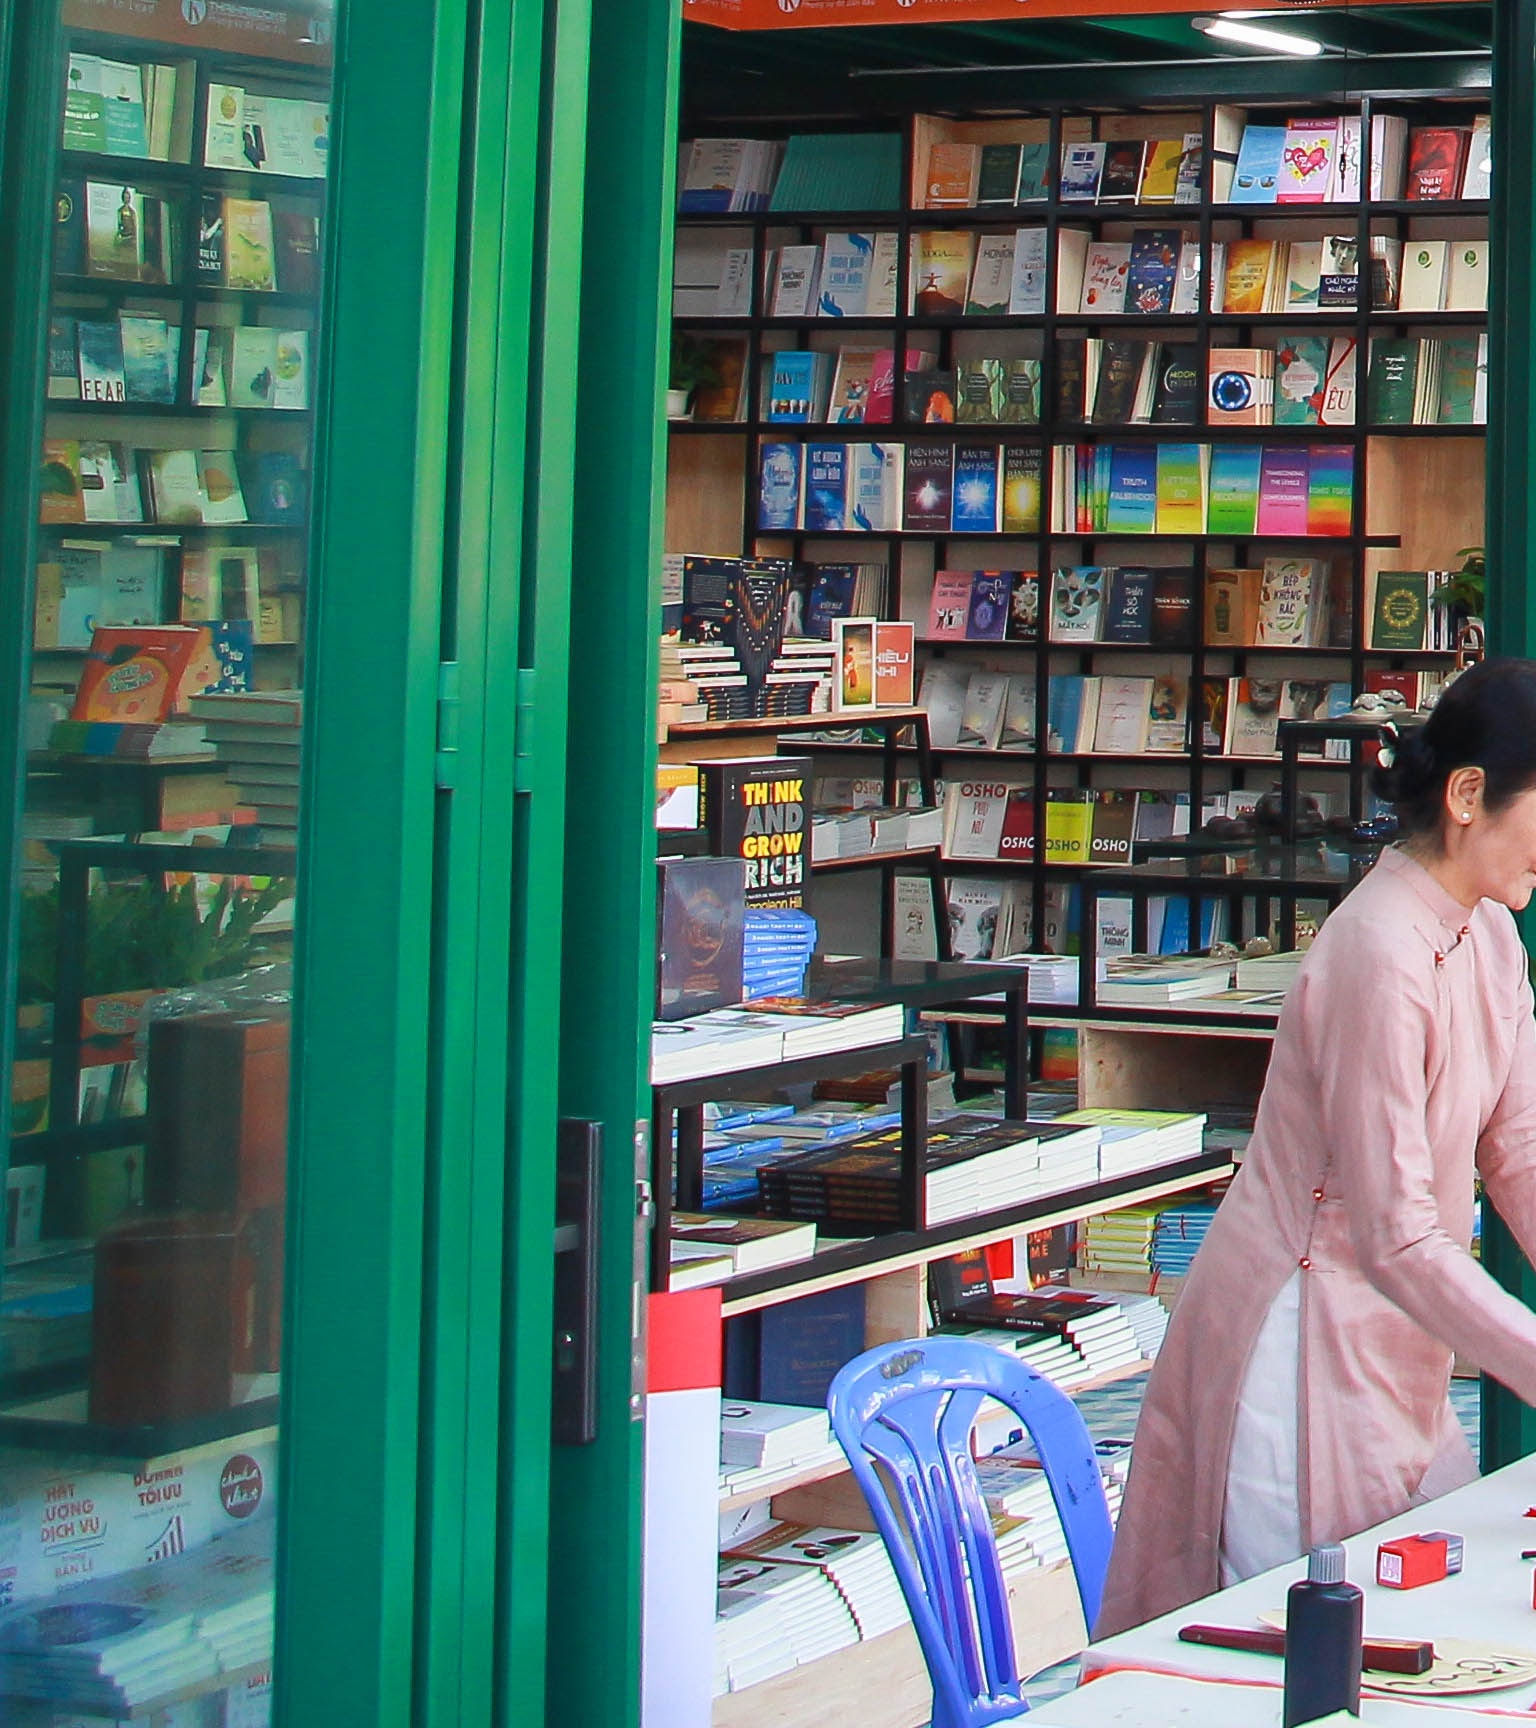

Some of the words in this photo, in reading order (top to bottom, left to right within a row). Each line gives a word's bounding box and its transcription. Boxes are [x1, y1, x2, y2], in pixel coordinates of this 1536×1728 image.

[83, 379, 125, 402] FEAR
[1121, 477, 1147, 487] TRUTH
[1273, 587, 1302, 602] KHÔNG
[873, 645, 909, 664] HIẾU
[742, 779, 804, 807] THINK
[853, 779, 884, 795] OSHO
[960, 782, 1007, 799] OSHO
[745, 803, 804, 835] AND
[742, 832, 803, 859] GROW
[1045, 839, 1081, 852] OSHO
[1092, 838, 1128, 852] OSHO
[744, 857, 803, 889] RICH
[40, 1522, 76, 1543] DỊCH
[79, 1516, 100, 1535] VỤ
